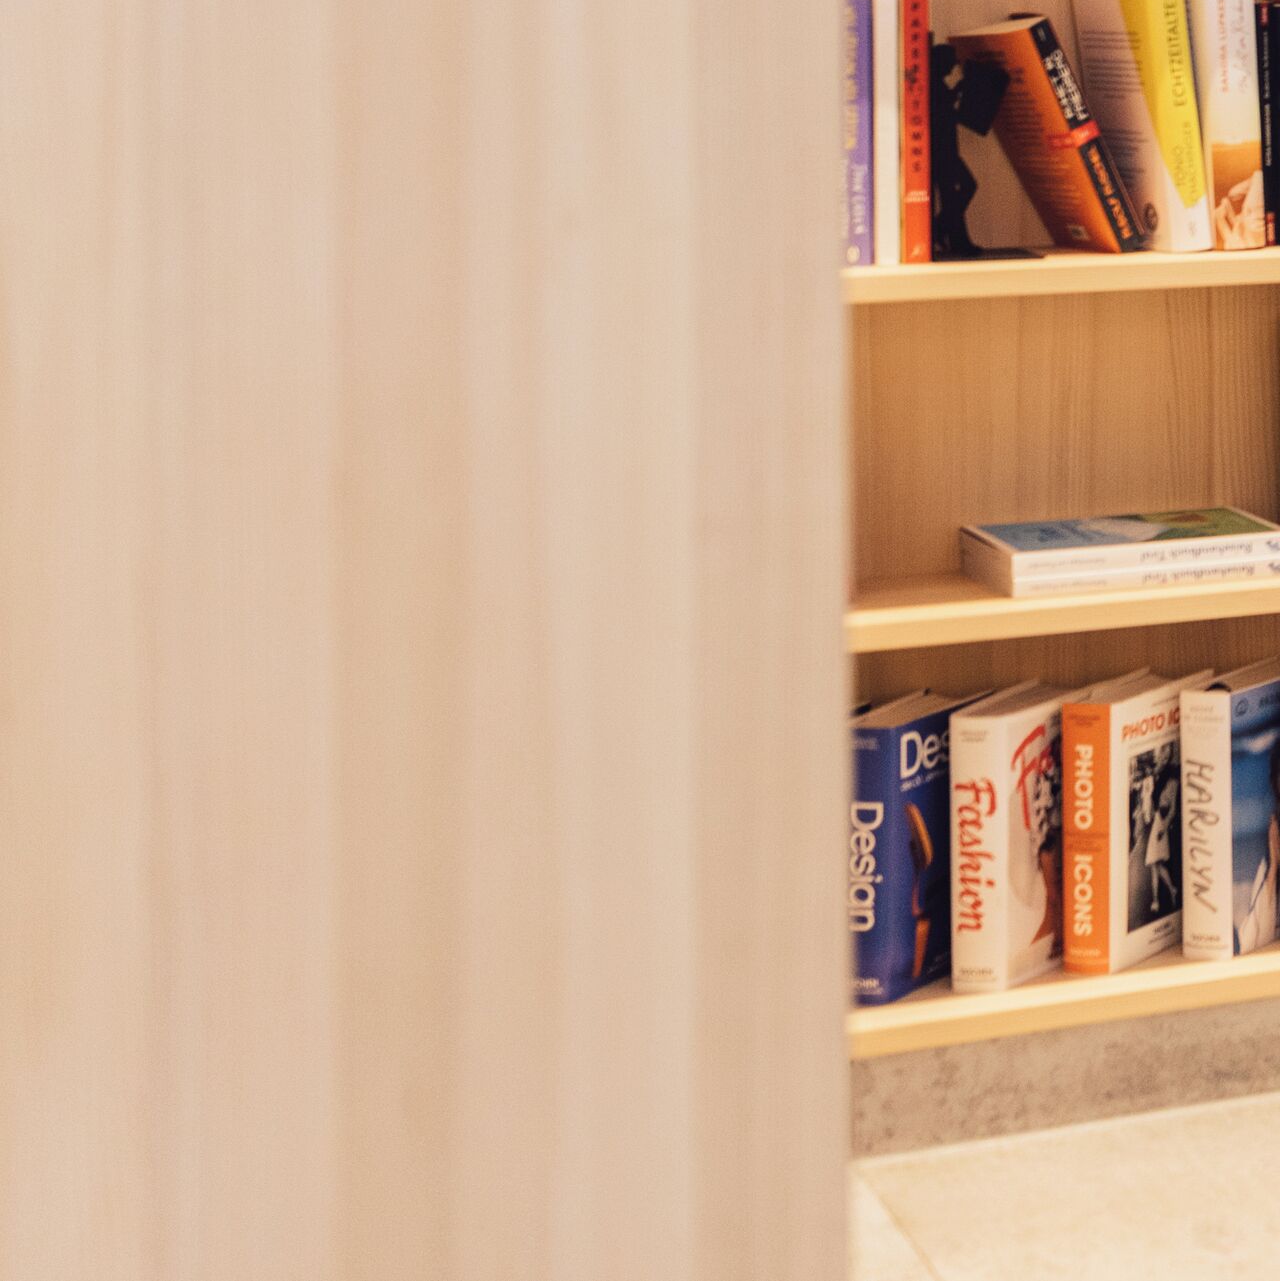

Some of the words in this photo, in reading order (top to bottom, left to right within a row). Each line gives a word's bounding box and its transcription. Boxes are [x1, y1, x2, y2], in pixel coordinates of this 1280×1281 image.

[1122, 714, 1164, 742] PHOTO
[1074, 744, 1094, 830] PHOTO
[850, 802, 884, 932] Design
[954, 777, 997, 933] Fashion
[1074, 854, 1094, 937] ICONS
